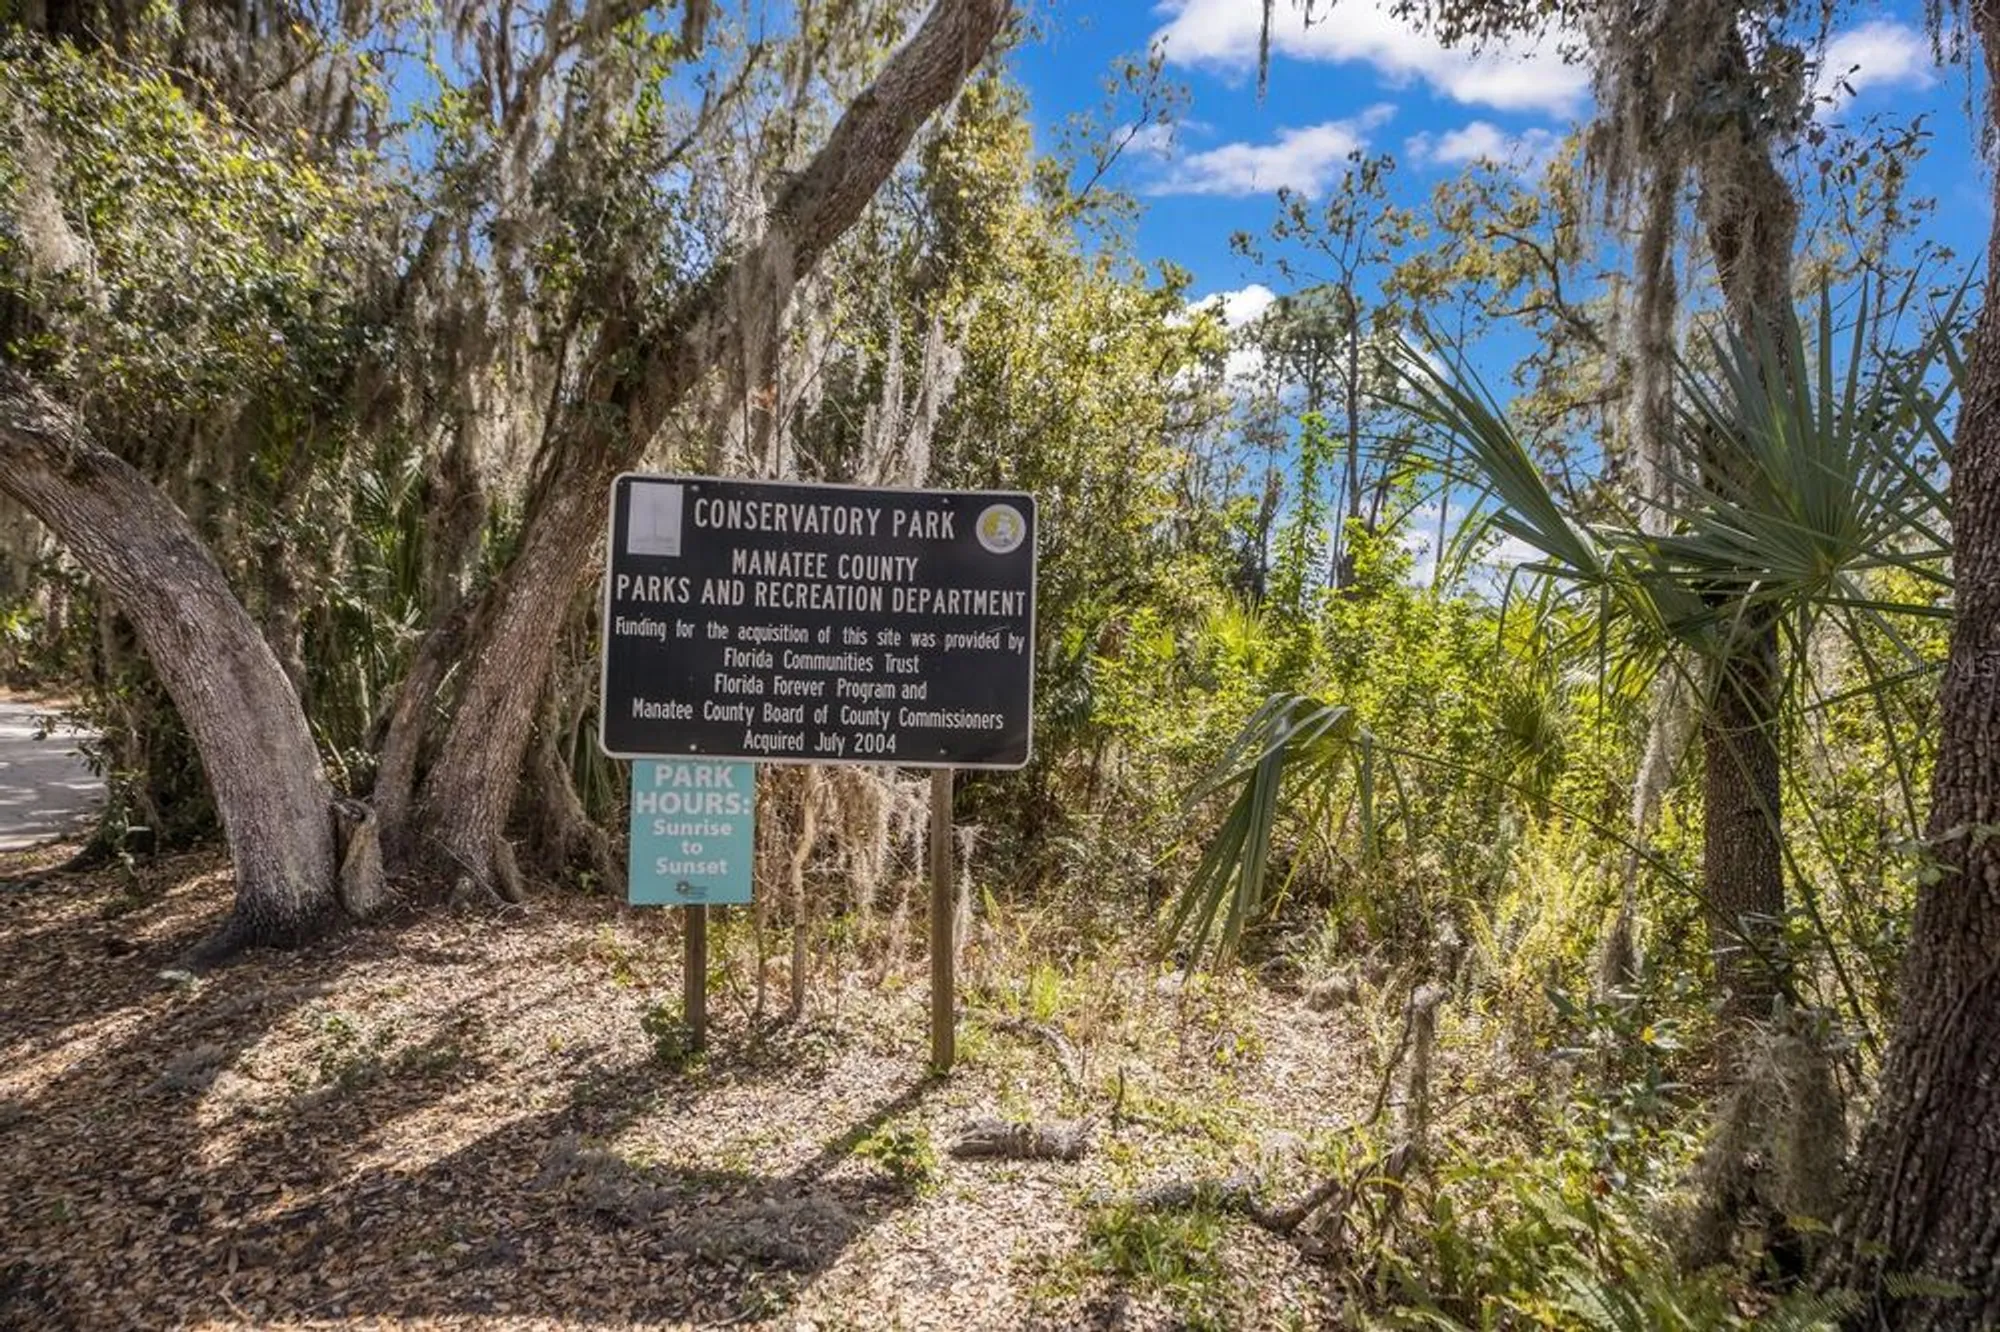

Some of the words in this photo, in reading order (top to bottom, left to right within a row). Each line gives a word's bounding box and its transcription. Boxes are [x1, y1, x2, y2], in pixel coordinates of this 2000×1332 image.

[694, 498, 882, 537] CONSERVATORY
[892, 509, 955, 540] PARK
[731, 548, 828, 580] MANATEE
[837, 553, 919, 583] COUNTY
[616, 573, 691, 604] PARKS
[701, 579, 745, 606] AND
[755, 581, 883, 613] RECREATION
[892, 587, 1026, 617] DEPARTMENT
[615, 616, 667, 642] Funding
[675, 619, 695, 639] for
[707, 621, 729, 640] the
[738, 623, 809, 644] acquisition
[817, 625, 831, 645] of
[842, 626, 868, 646] this
[876, 627, 902, 647] site
[910, 632, 937, 648] was
[944, 630, 1000, 651] provided
[1008, 631, 1026, 655] by
[724, 647, 773, 669] Florida
[783, 649, 874, 673] Communities
[883, 652, 920, 674] Trust
[714, 673, 764, 695] Florida
[773, 675, 826, 697] Forever
[836, 677, 896, 704] Program
[901, 680, 928, 701] and
[632, 697, 694, 720] Manatee
[703, 700, 755, 726] County
[763, 703, 804, 724] Board
[813, 704, 829, 725] of
[840, 704, 891, 731] County
[898, 707, 1005, 731] Commissioners
[743, 729, 804, 755] Acquired
[814, 731, 846, 757] July
[853, 732, 897, 754] 2004
[654, 763, 735, 789] PARK
[636, 791, 751, 816] HOURS:
[653, 818, 733, 837] Sunrise
[681, 840, 704, 856] to
[655, 857, 729, 876] Sunset
